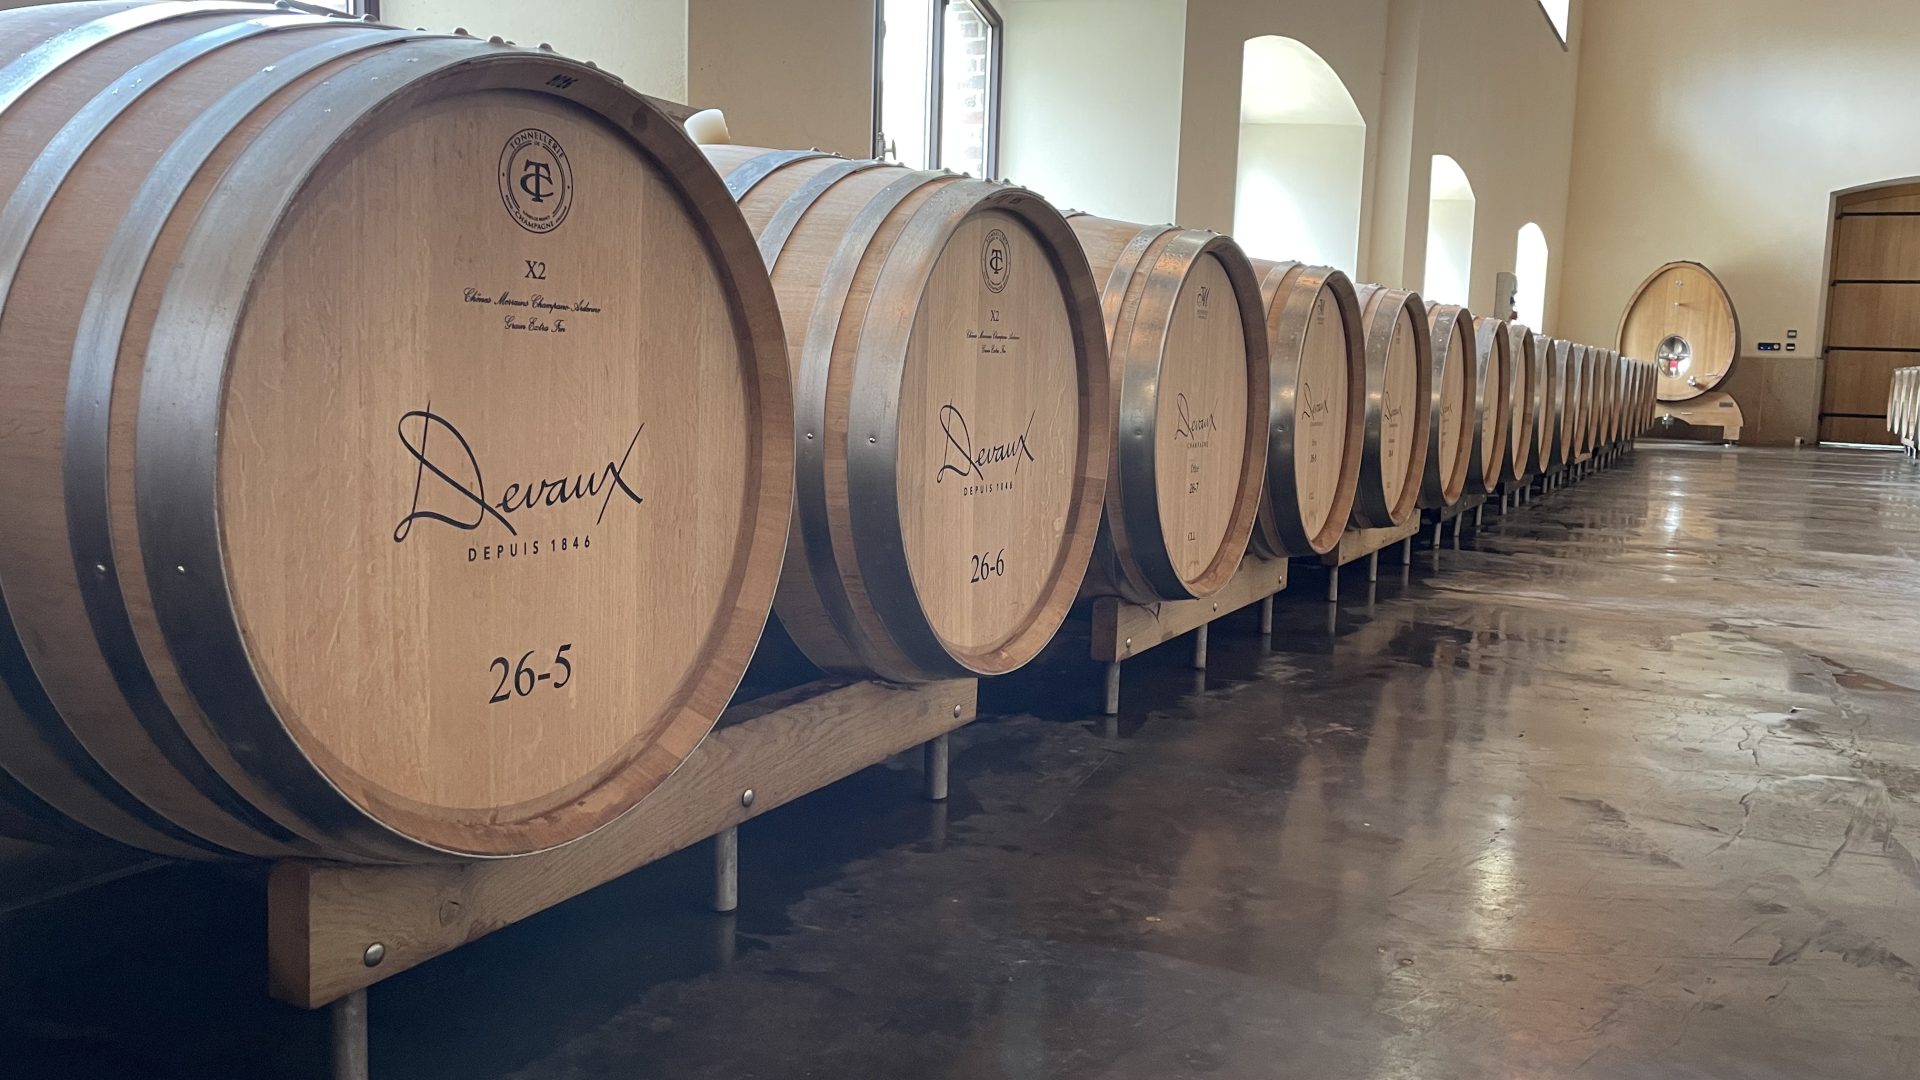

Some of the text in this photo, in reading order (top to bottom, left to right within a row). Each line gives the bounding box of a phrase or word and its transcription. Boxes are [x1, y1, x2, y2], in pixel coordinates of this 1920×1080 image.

[509, 131, 565, 159] TONNELLERIE
[514, 211, 555, 231] CHAMPAGNE
[524, 260, 547, 280] X2
[1174, 392, 1219, 441] Devaux
[936, 397, 1036, 484] Devaux
[392, 399, 646, 543] Devaux
[963, 483, 993, 497] DEPUIS
[468, 535, 592, 562] DEPUIS 1846
[970, 548, 1006, 584] 26-6
[488, 643, 573, 705] 26-5
